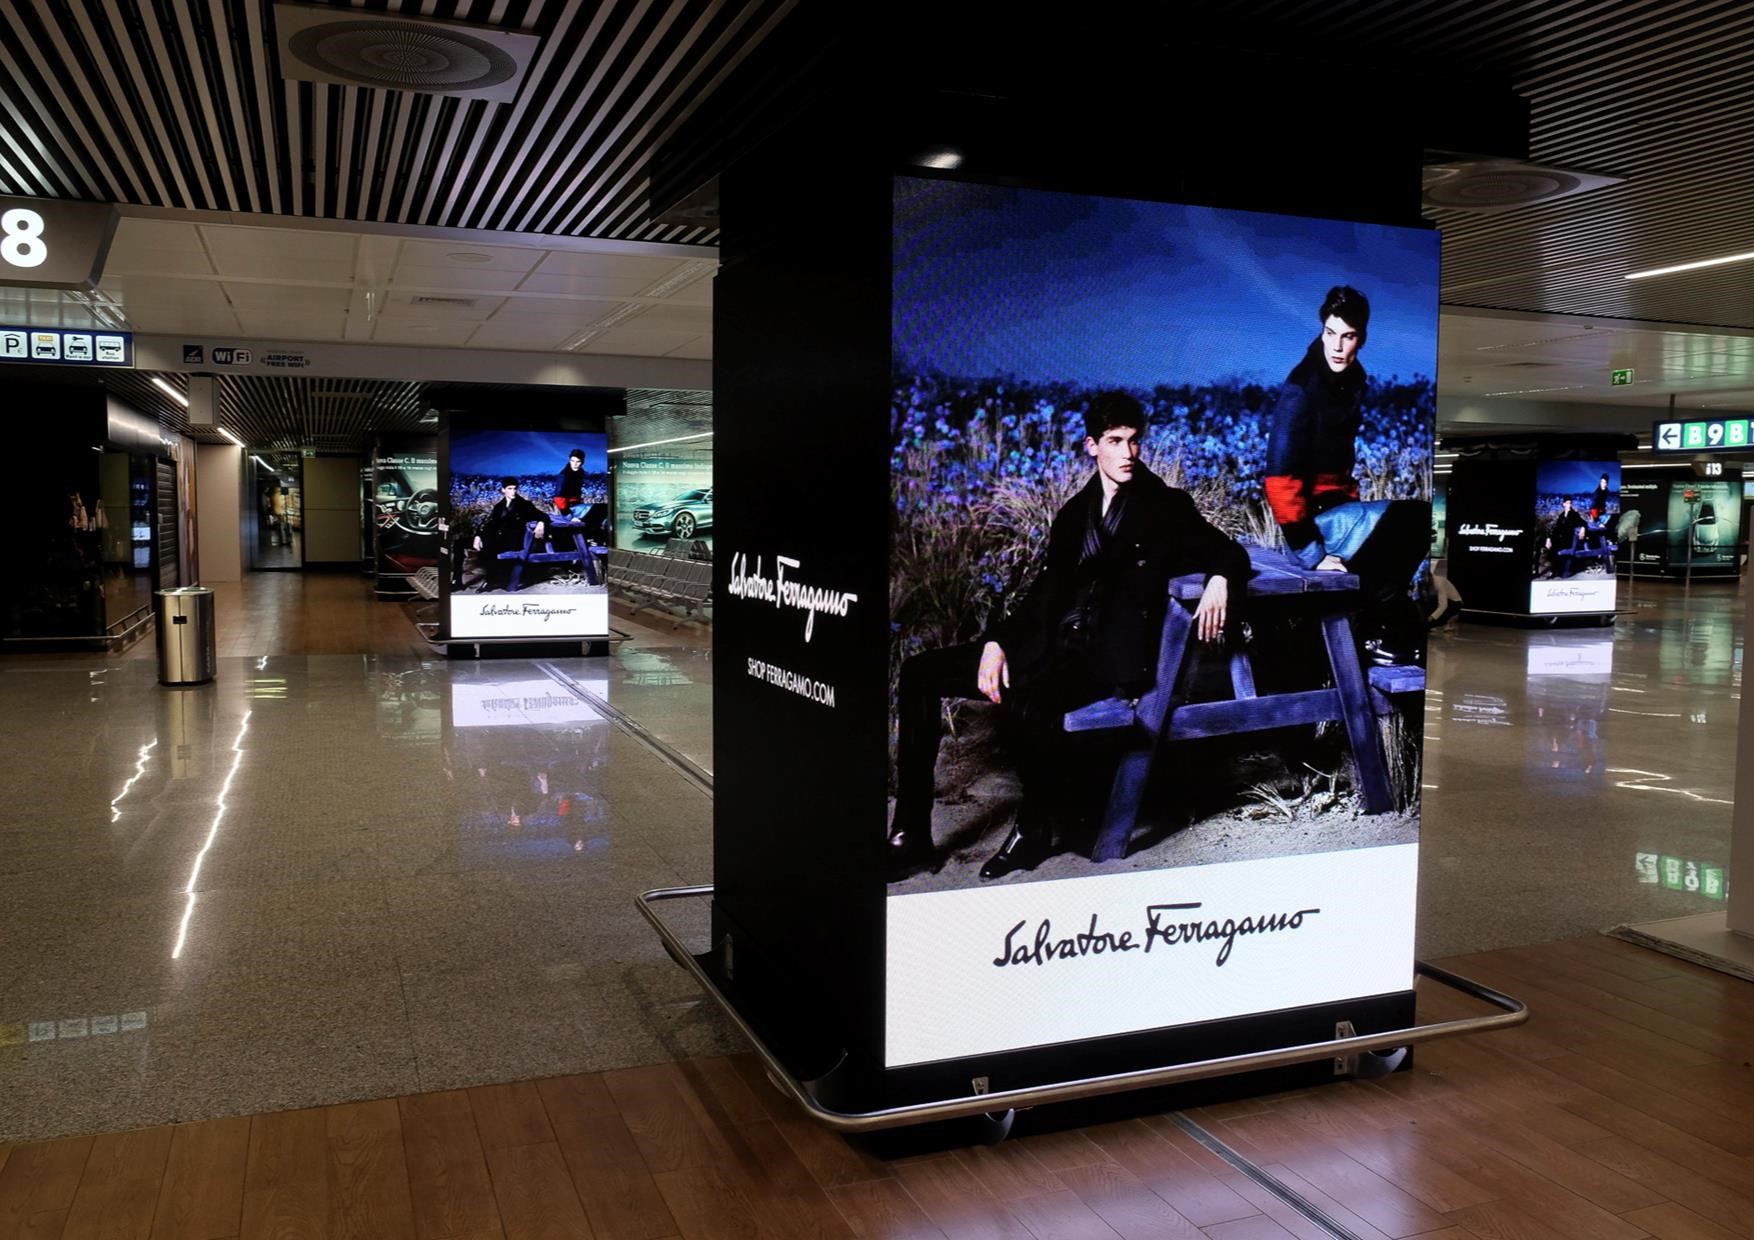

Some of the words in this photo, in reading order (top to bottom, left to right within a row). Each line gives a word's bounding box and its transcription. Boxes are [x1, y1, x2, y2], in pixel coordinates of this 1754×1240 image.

[1, 208, 47, 268] 8
[480, 604, 521, 616] Salvatore
[522, 603, 577, 622] Ferragamo
[728, 551, 776, 602] Salvatore
[776, 555, 858, 643] Ferragamo
[748, 657, 766, 680] SHOP
[766, 663, 836, 708] FERRAGAMO.COM
[993, 913, 1140, 967] Salvatore
[1144, 902, 1321, 967] Ferragamo
